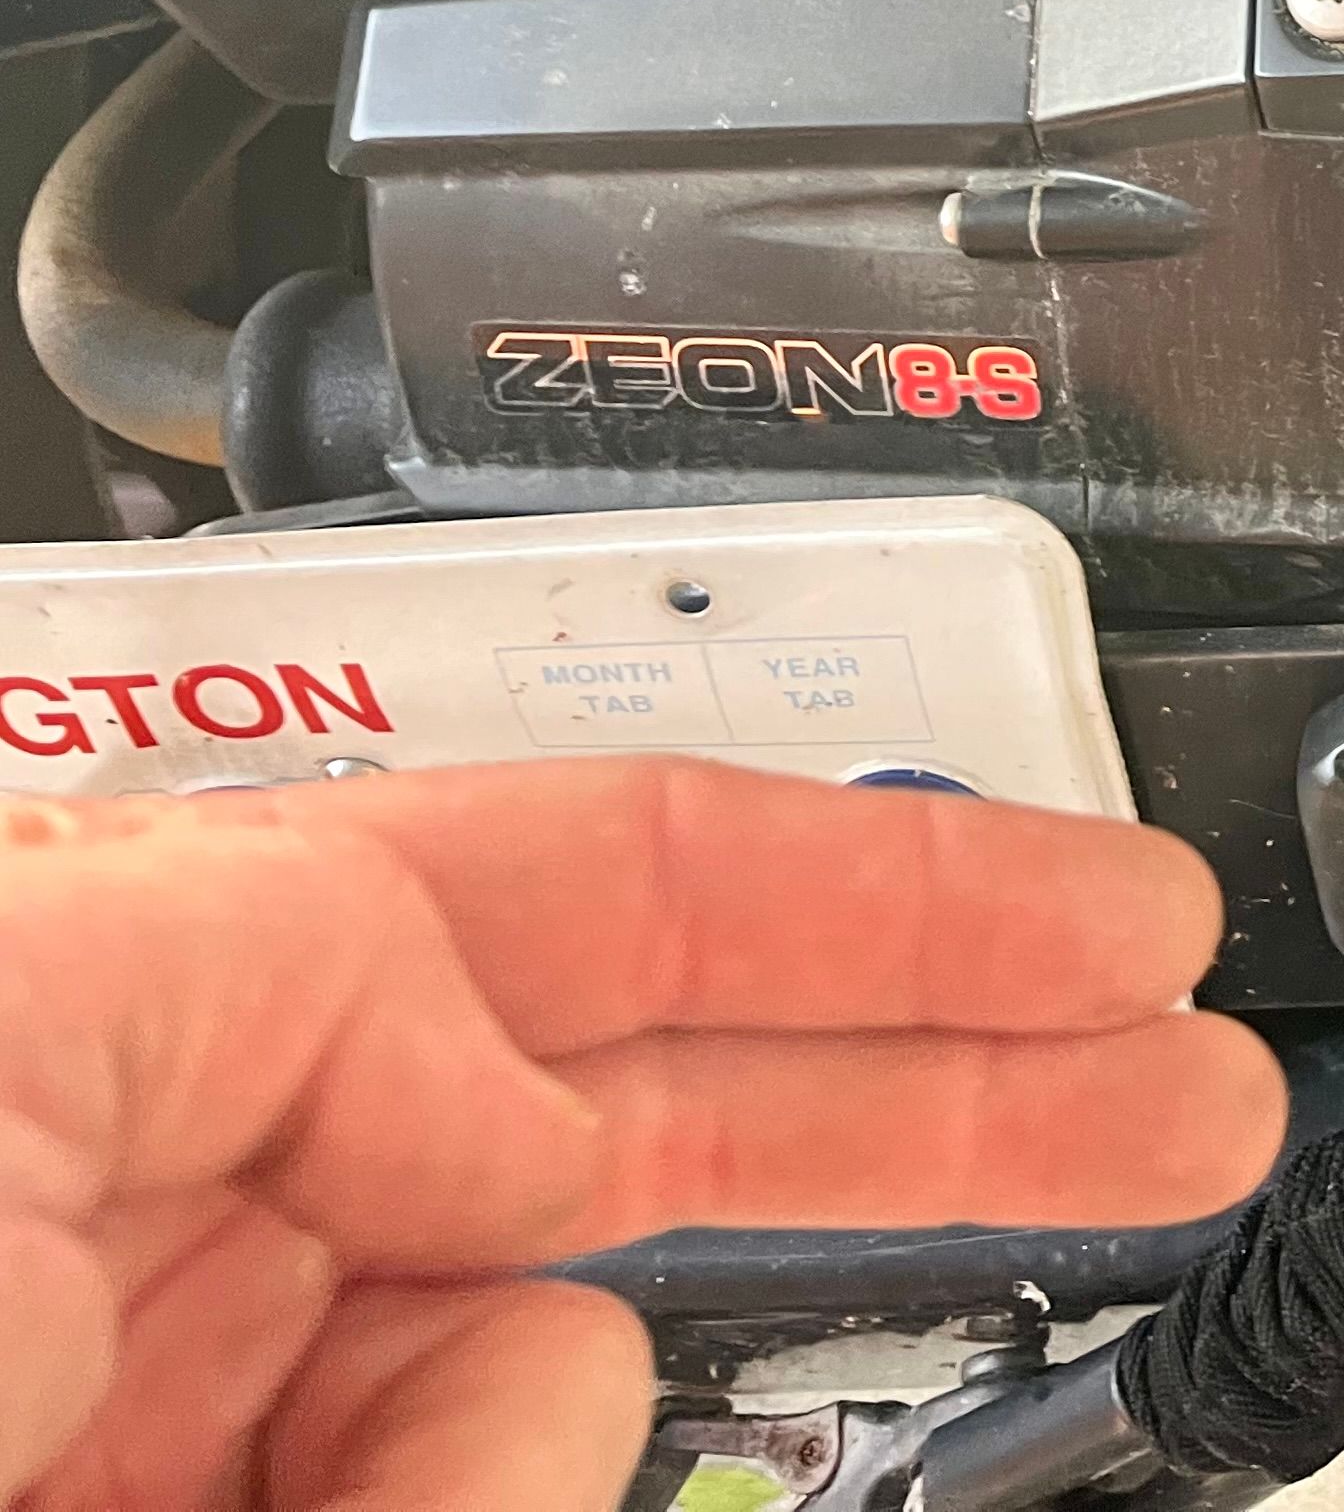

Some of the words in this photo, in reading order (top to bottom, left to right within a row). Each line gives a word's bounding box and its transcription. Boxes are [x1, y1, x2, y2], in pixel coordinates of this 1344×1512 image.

[485, 331, 894, 417] ZEON
[541, 661, 672, 685] MONTH
[763, 656, 860, 679] YEAR
[0, 663, 395, 756] GTON
[579, 694, 653, 715] TAB
[783, 689, 856, 711] TAB
